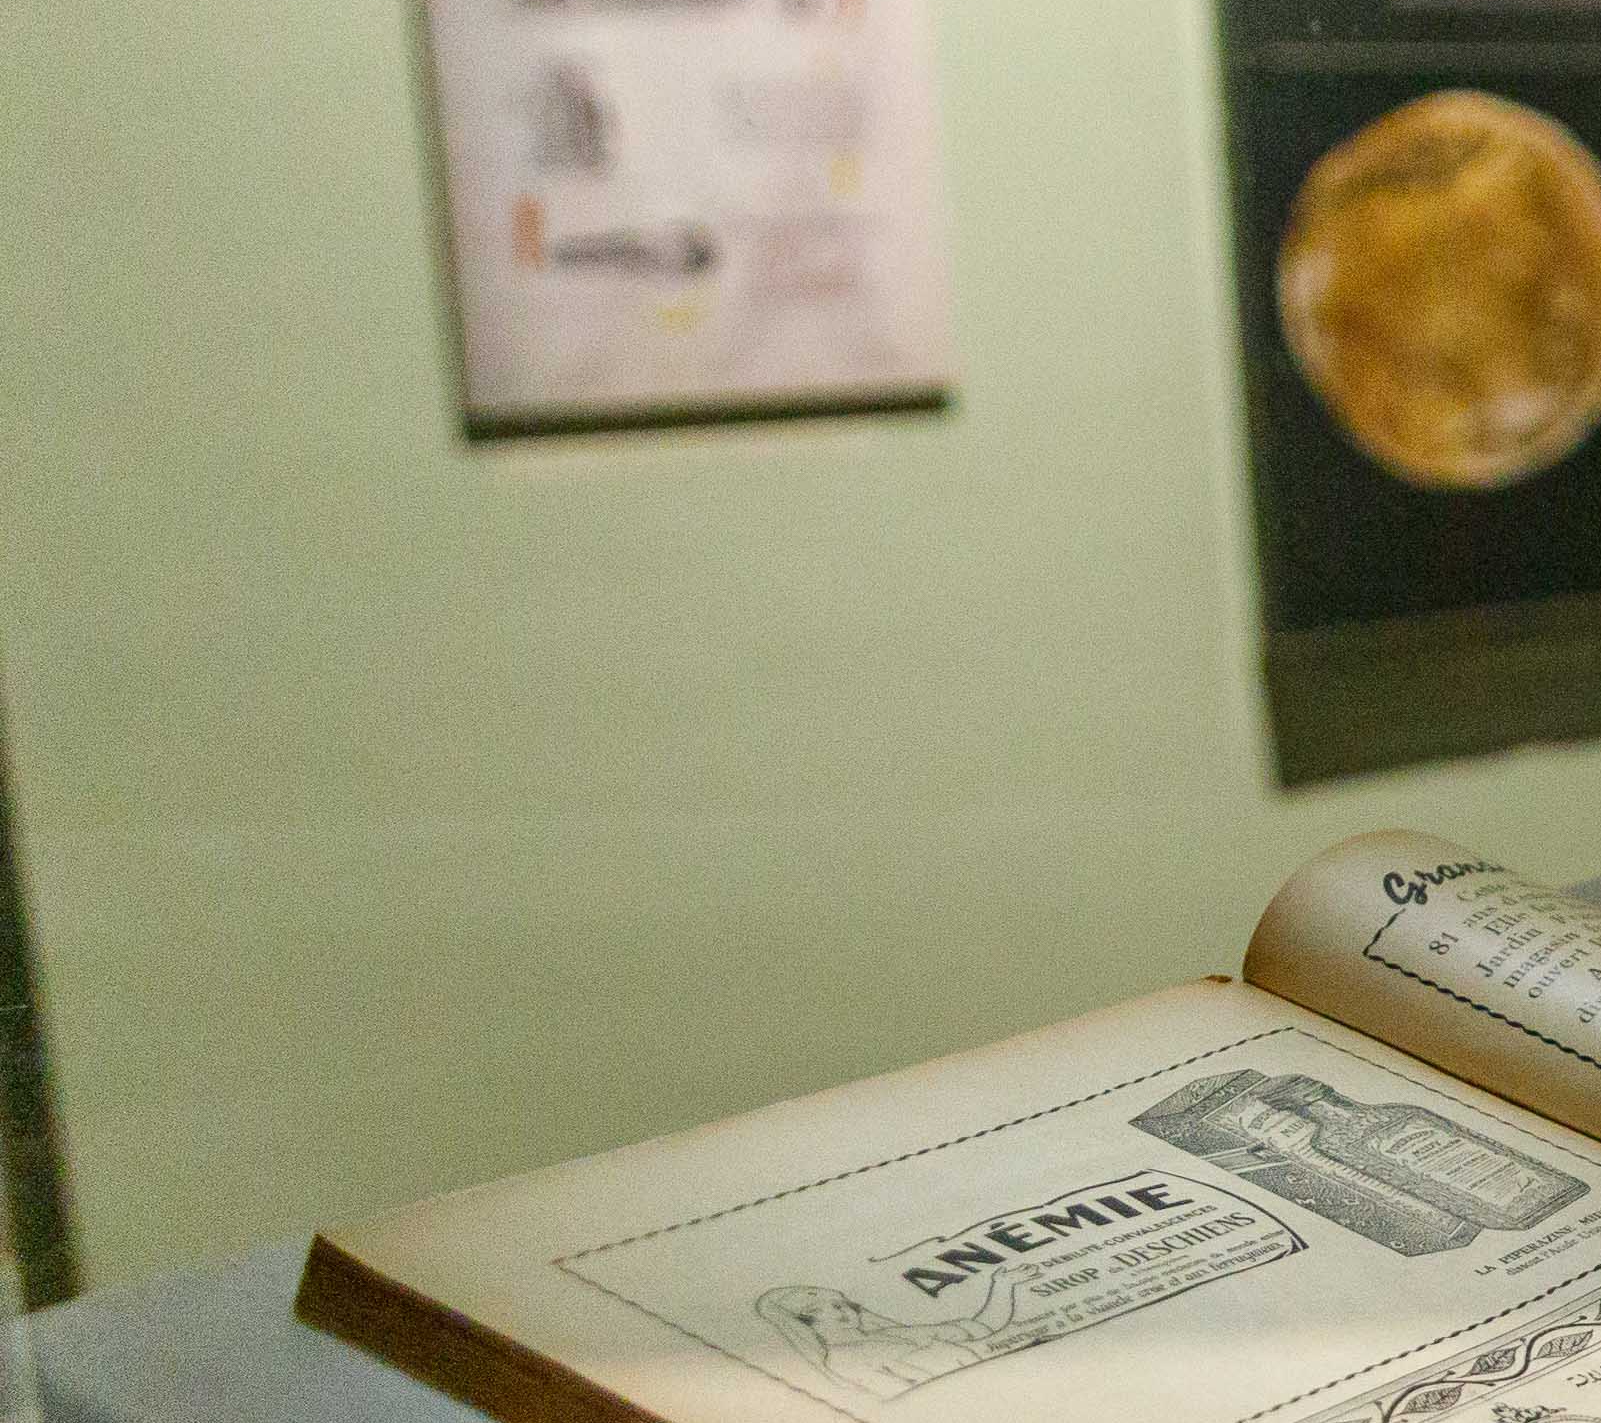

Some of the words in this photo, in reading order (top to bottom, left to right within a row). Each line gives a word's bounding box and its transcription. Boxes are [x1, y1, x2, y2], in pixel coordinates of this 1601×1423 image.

[1429, 931, 1459, 956] 81
[1476, 926, 1543, 978] Jardin
[1503, 930, 1580, 989] magasin
[1528, 947, 1592, 1000] ouvert
[903, 1181, 1194, 1299] ANÉMIE
[1029, 1267, 1100, 1299] SIROP
[1119, 1211, 1257, 1269] DESCHIENS
[1474, 1263, 1498, 1278] LA
[1498, 1224, 1575, 1266] PIPERAZINE
